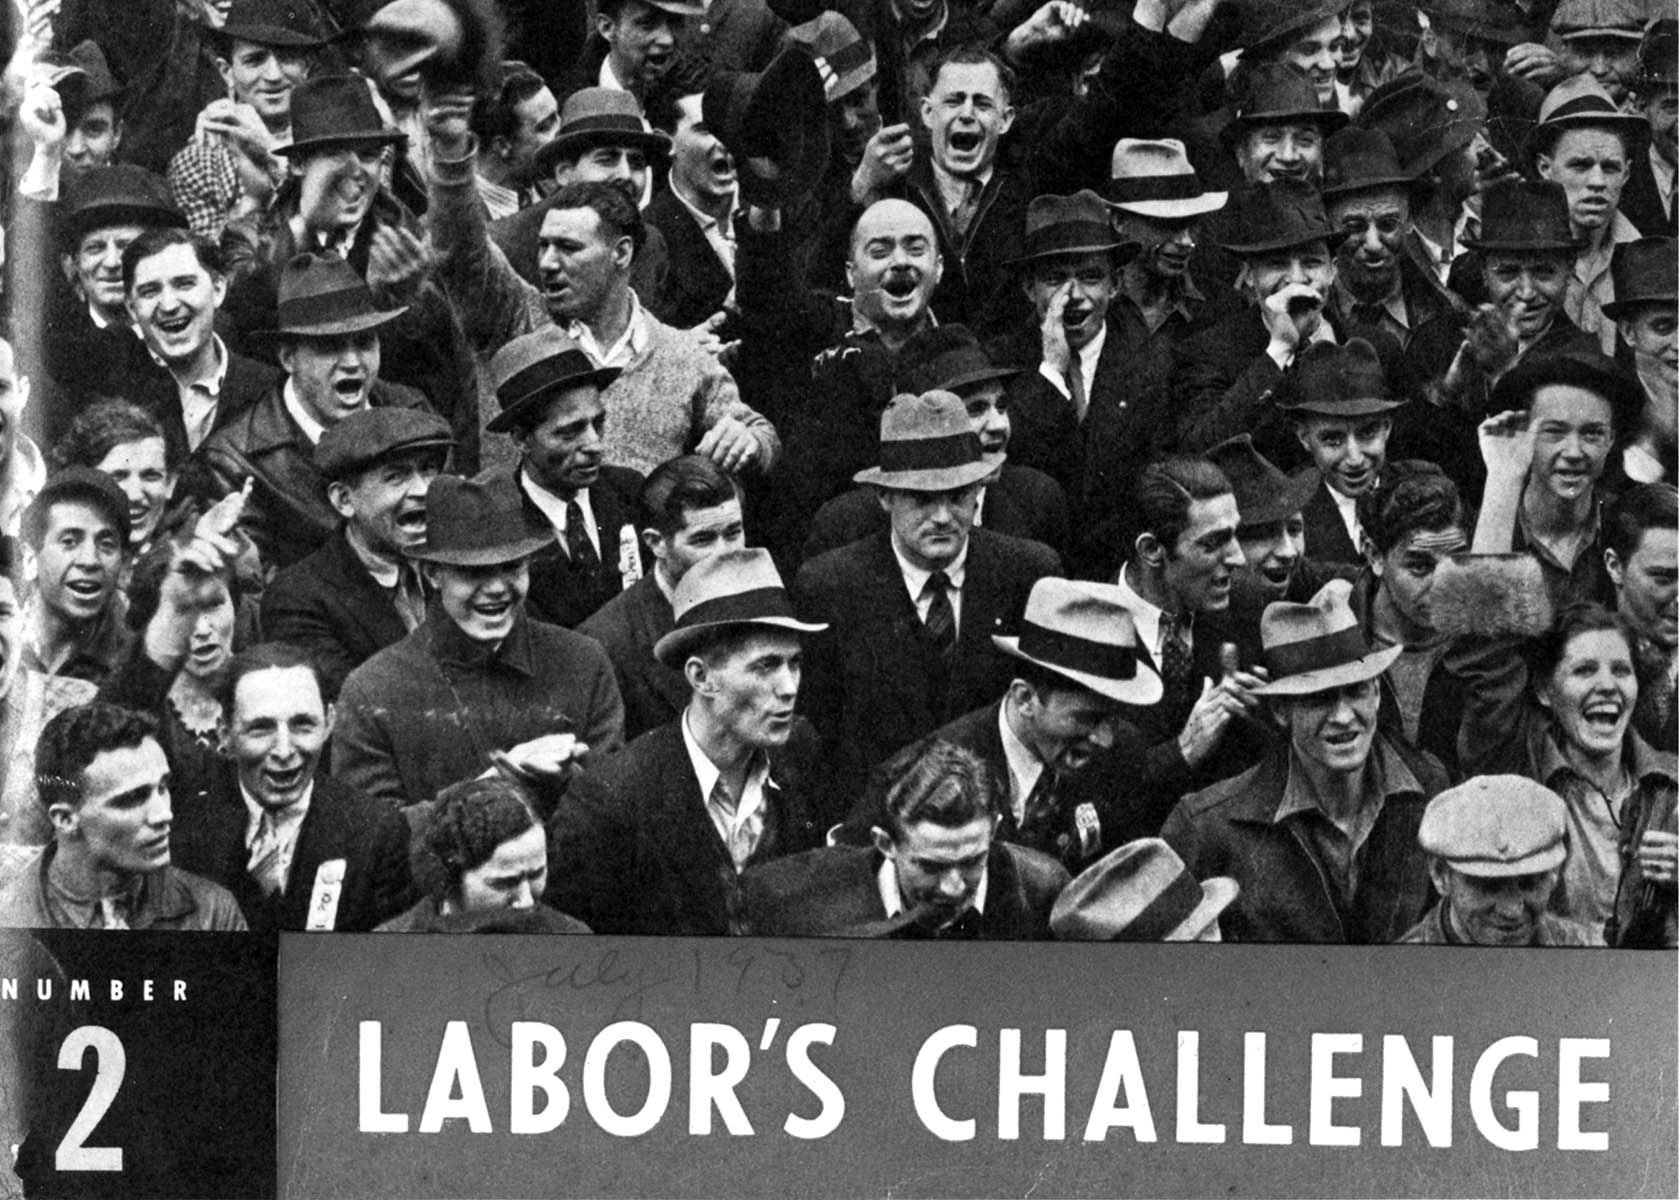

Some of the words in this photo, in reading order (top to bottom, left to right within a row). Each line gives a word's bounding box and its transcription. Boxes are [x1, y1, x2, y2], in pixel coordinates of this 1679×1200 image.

[1, 978, 187, 1001] NUMBER
[56, 1025, 126, 1171] 2
[360, 1019, 844, 1138] LABOR'S
[912, 1024, 1610, 1151] CHALLENGE
